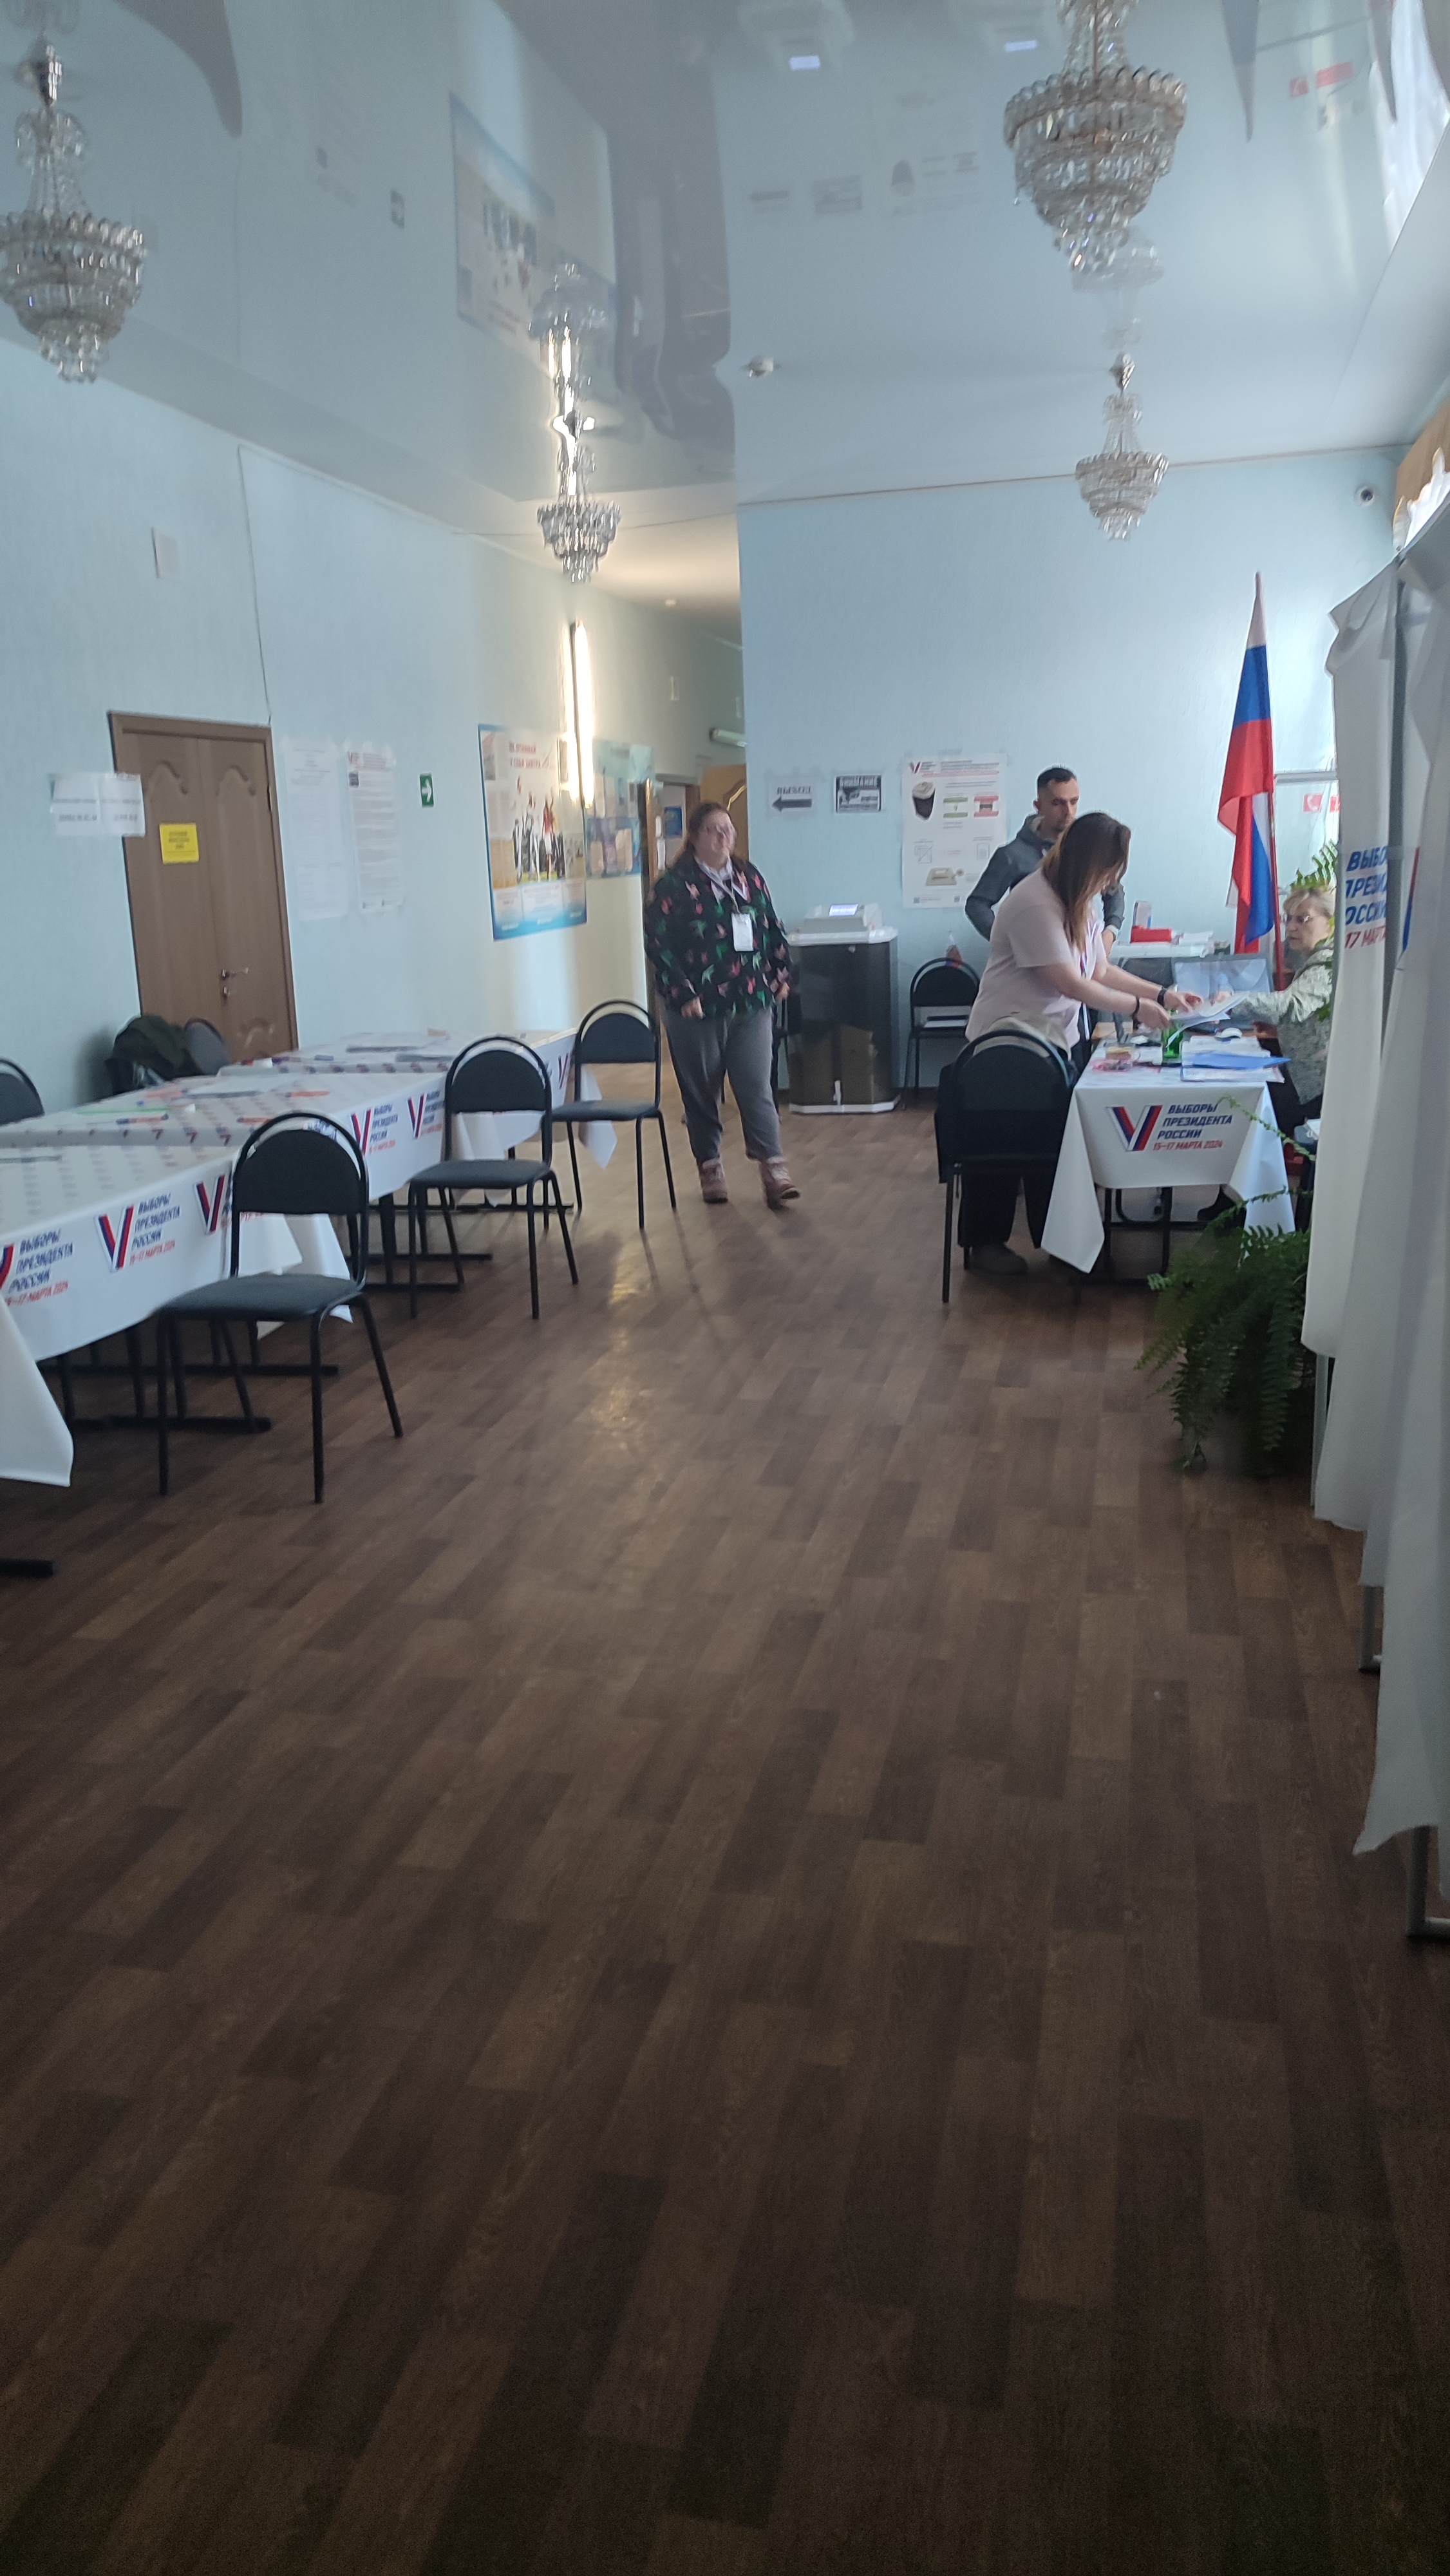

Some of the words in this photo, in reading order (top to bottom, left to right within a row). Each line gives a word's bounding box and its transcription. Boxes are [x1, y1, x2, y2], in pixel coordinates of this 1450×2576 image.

[1167, 1103, 1218, 1114] ВЫБОРЫ
[1162, 1115, 1232, 1127] ПРЕЗИДЕНТА
[1157, 1129, 1203, 1139] РОССИИ
[1176, 1141, 1203, 1150] МАРТА
[1203, 1140, 1223, 1149] 2024
[138, 1193, 171, 1216] ВЫБОРЫ
[134, 1205, 180, 1234] ПРЕЗИДЕНТА
[19, 1228, 61, 1256] ВЫБОРЫ
[131, 1227, 162, 1251] РОССИИ
[16, 1242, 73, 1275] ПРЕЗИДЕНТА
[8, 1268, 50, 1294] РОССИИ
